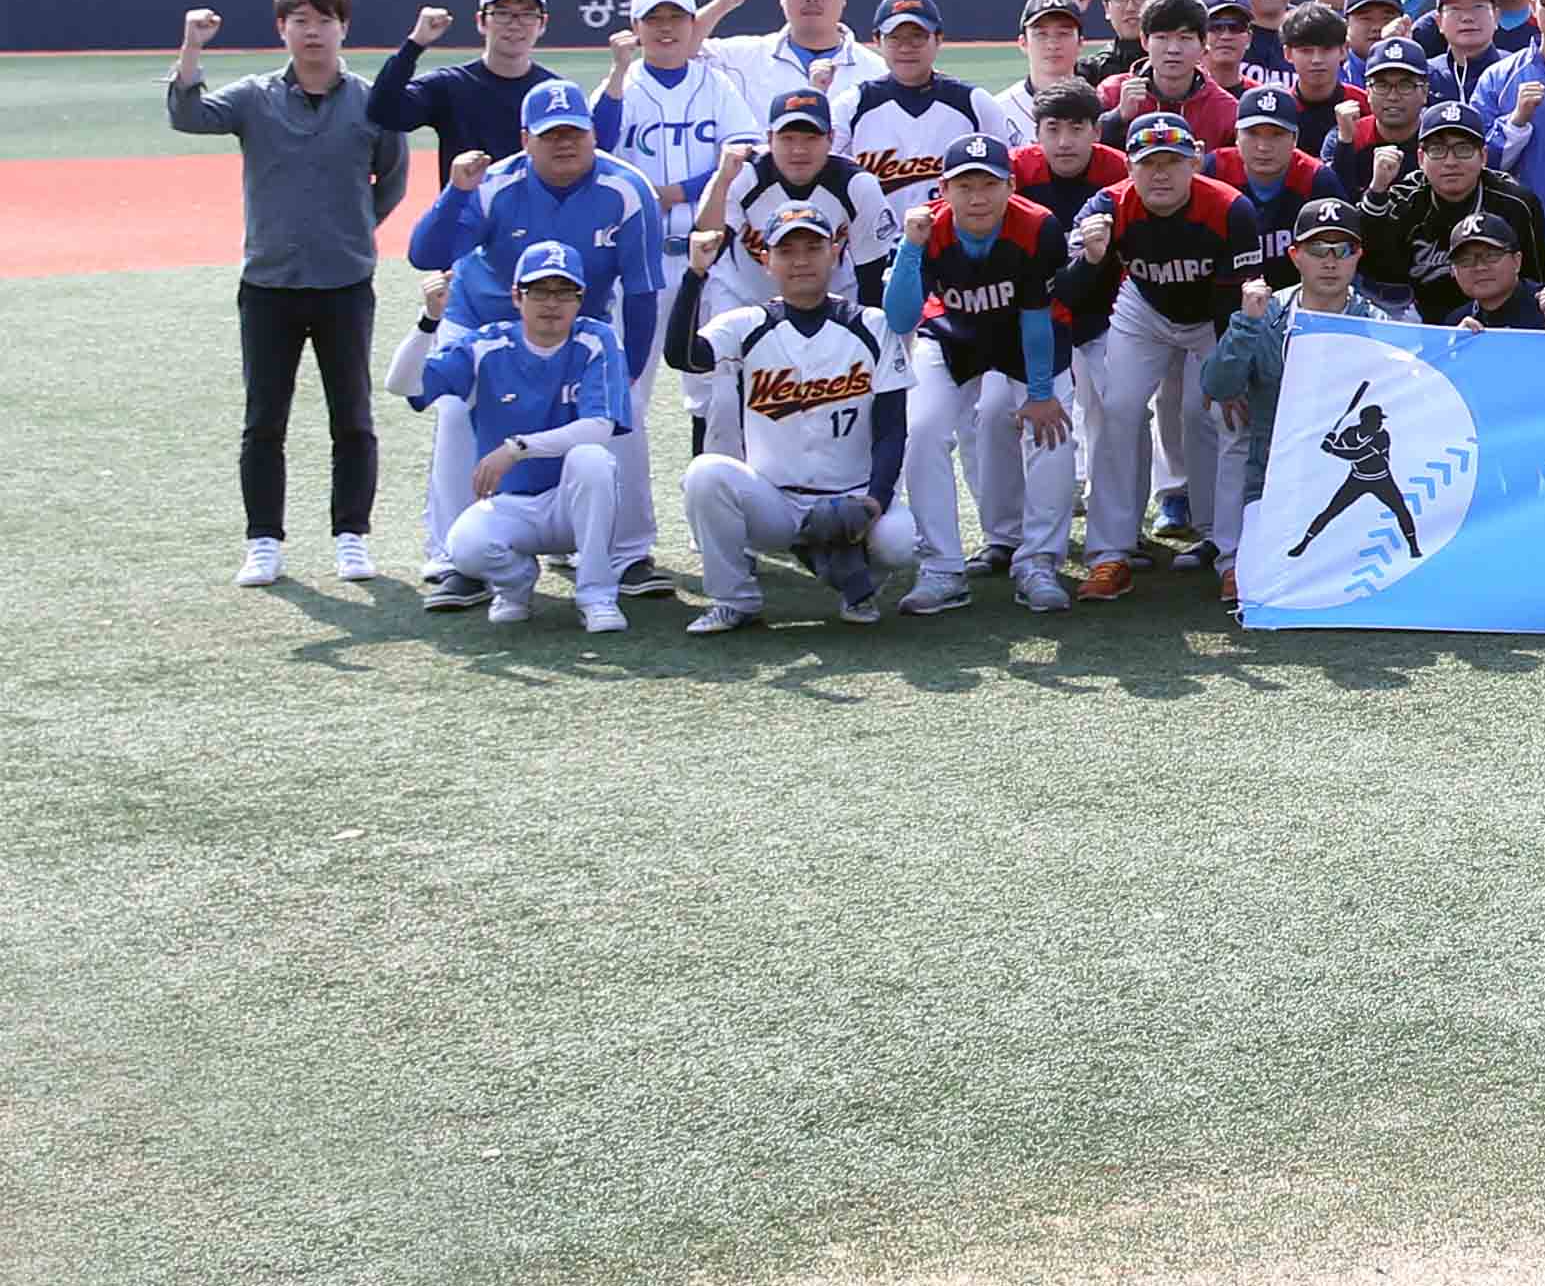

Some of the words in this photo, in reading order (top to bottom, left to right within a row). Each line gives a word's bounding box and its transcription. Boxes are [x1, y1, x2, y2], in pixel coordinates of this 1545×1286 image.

[545, 84, 572, 113] A
[1317, 201, 1343, 222] K
[747, 361, 873, 411] Weasels
[830, 407, 859, 439] 17
